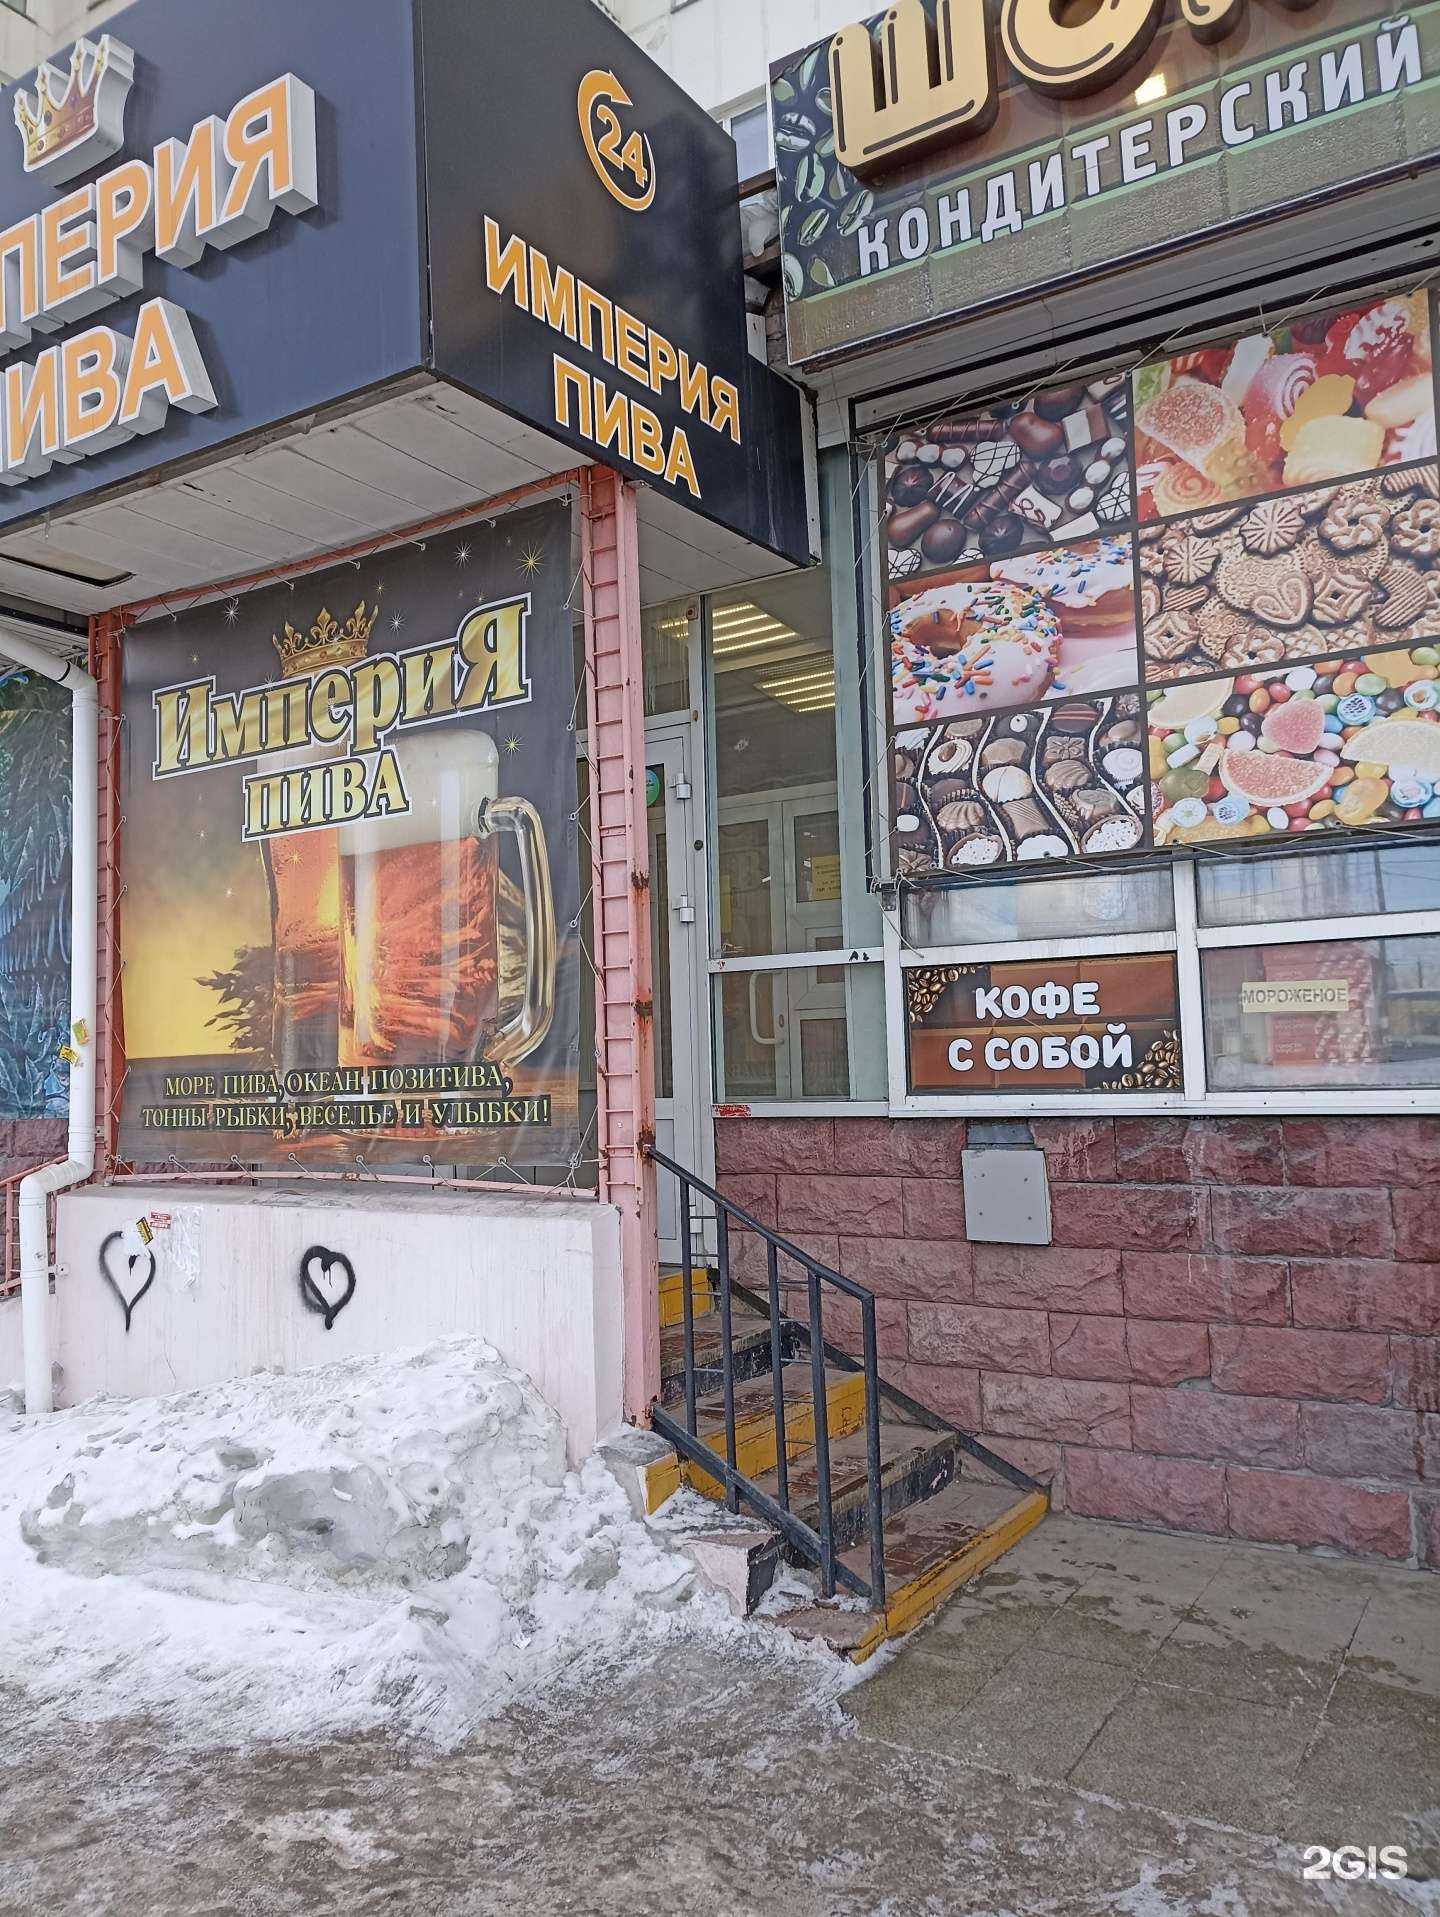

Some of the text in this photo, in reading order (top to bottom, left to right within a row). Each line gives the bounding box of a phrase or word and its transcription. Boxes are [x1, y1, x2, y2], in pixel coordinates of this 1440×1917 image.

[596, 104, 648, 188] 24
[858, 15, 1423, 276] КОНДИТЕРСКИЙ
[483, 214, 741, 445] ИМПЕРИЯ
[0, 297, 198, 475] ИВА
[553, 352, 702, 499] ПИВА
[975, 981, 1101, 1020] КОФЕ
[1242, 987, 1347, 1005] МОРОЖЕНОЕ
[948, 1022, 1134, 1072] С СОБОЙ
[142, 1100, 549, 1129] ТОННЫ РЫБКИ, ВЕСЕЛЬЕ И УЛЫБКИ!
[164, 1065, 511, 1097] МОРЕ ПИВА, ОКЕАН ПОЗИТИВА,
